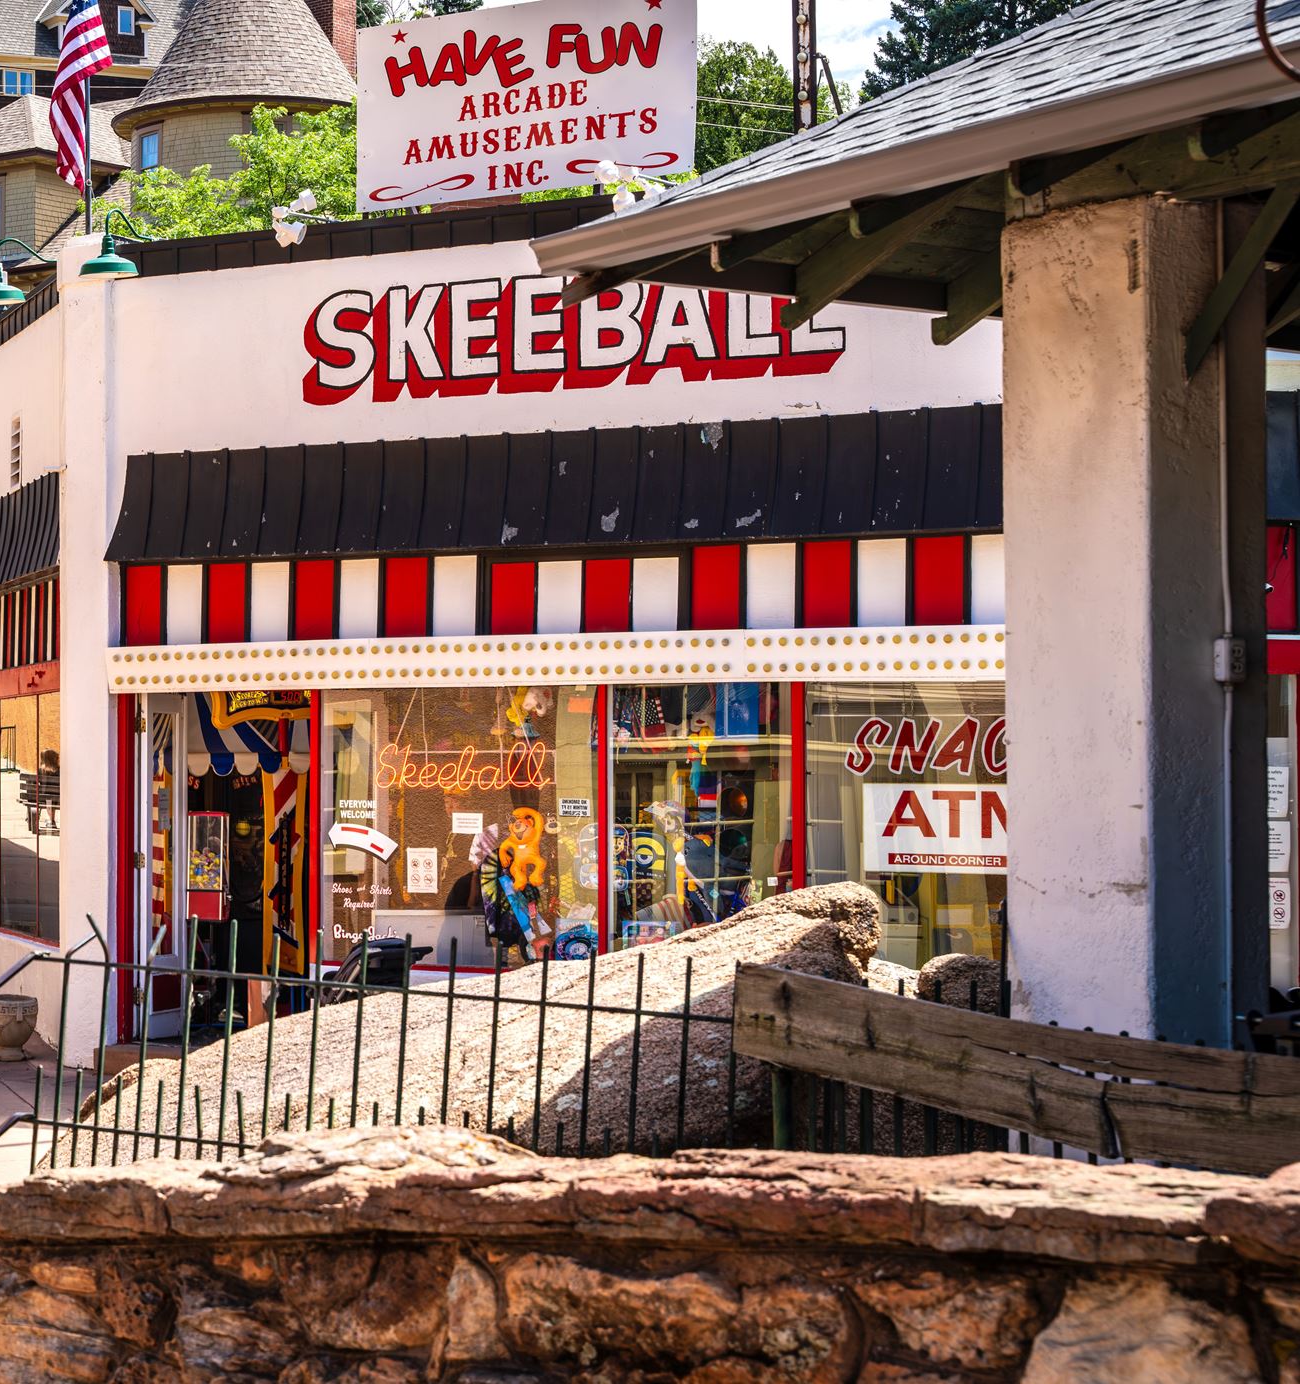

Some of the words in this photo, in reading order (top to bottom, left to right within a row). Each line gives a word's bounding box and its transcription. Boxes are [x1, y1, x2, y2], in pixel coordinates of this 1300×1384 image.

[383, 29, 534, 98] HAVE
[545, 21, 664, 74] FUN
[457, 79, 588, 122] ARCADE
[402, 107, 658, 165] AMUSEMENTS
[487, 159, 550, 191] INC.
[375, 741, 551, 790] Skeeball
[340, 810, 377, 819] WELCOME
[894, 854, 947, 865] AROUND
[949, 855, 1002, 866] CORNER
[331, 882, 353, 894] Shoes
[369, 884, 393, 895] Shirts
[343, 897, 376, 912] Required
